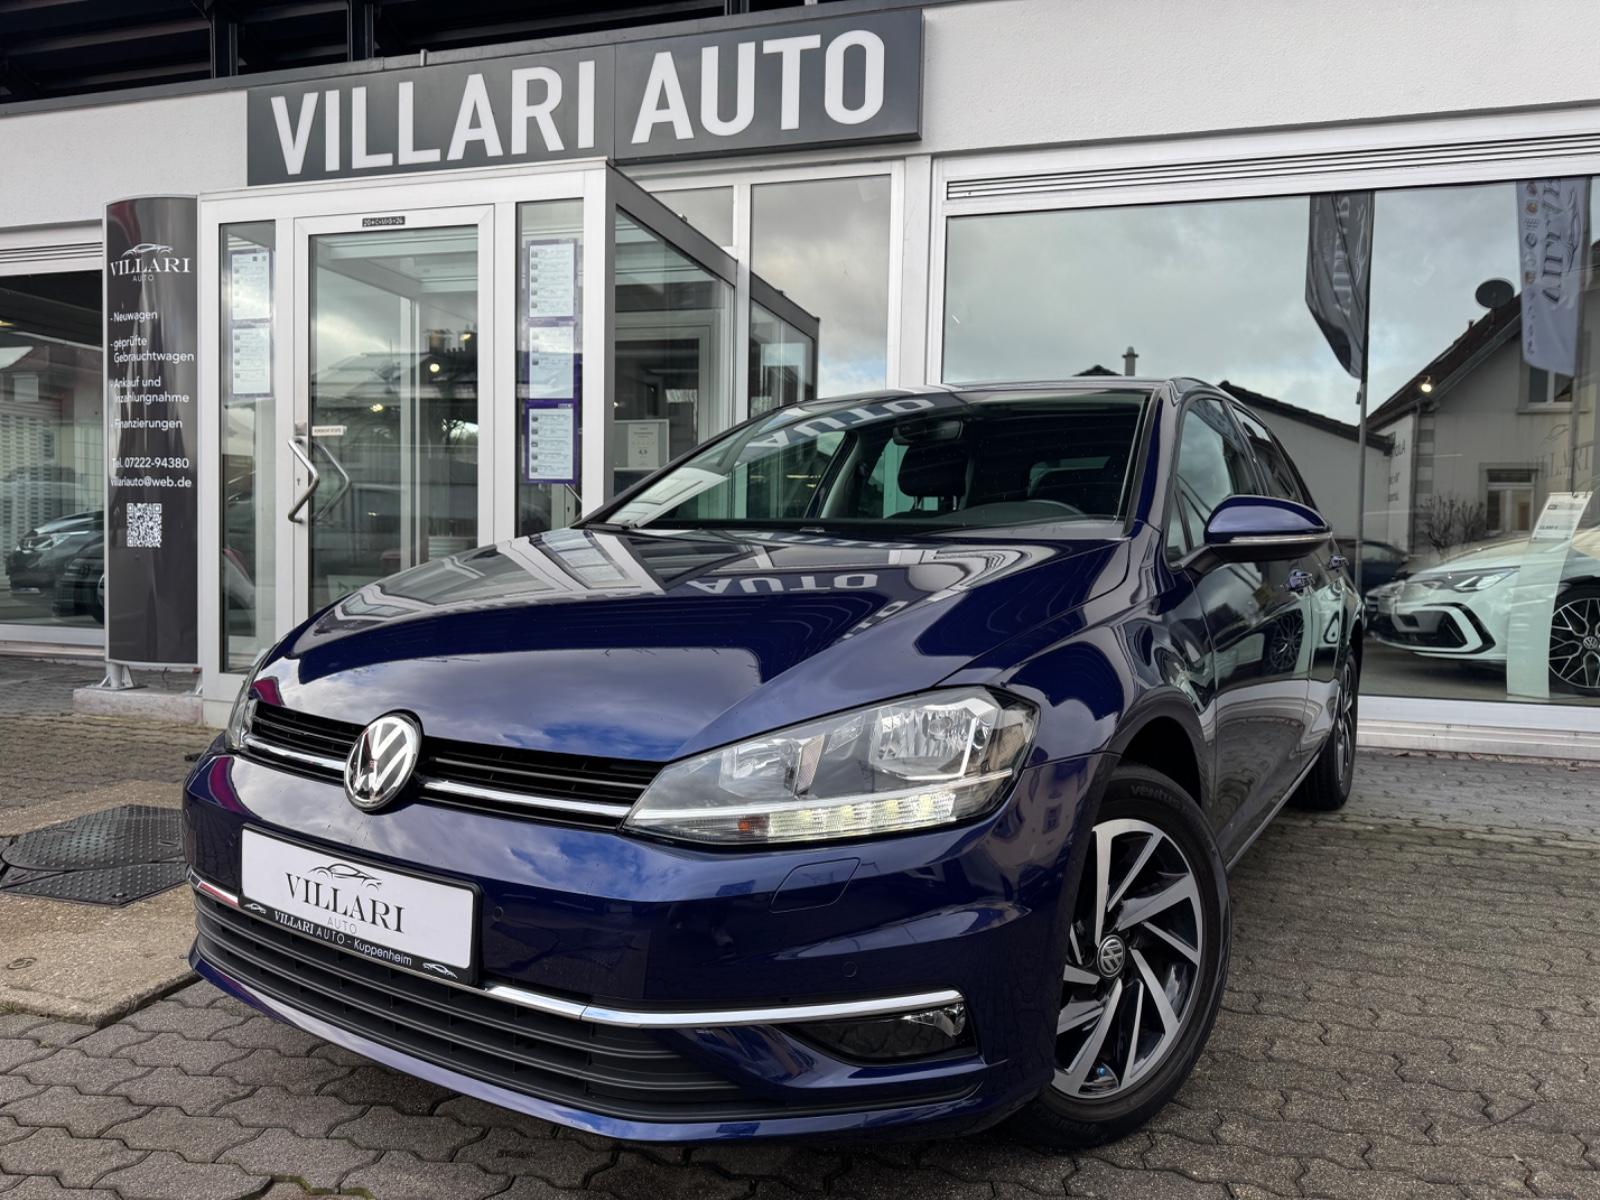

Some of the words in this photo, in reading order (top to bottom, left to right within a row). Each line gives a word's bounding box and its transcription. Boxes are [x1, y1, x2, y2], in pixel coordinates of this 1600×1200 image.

[271, 60, 595, 176] VILLARI
[631, 30, 885, 144] AUTO
[110, 257, 191, 277] VILLARI
[132, 274, 154, 282] AUTO
[113, 350, 195, 364] Gebrauchtwagen
[142, 376, 161, 388] und
[125, 457, 190, 469] 07222-94380
[285, 872, 405, 934] VILLARI
[327, 916, 357, 935] AUTO
[274, 910, 315, 934] VILLARI
[316, 927, 345, 945] AUTO
[353, 938, 412, 967] Kuppenheim
